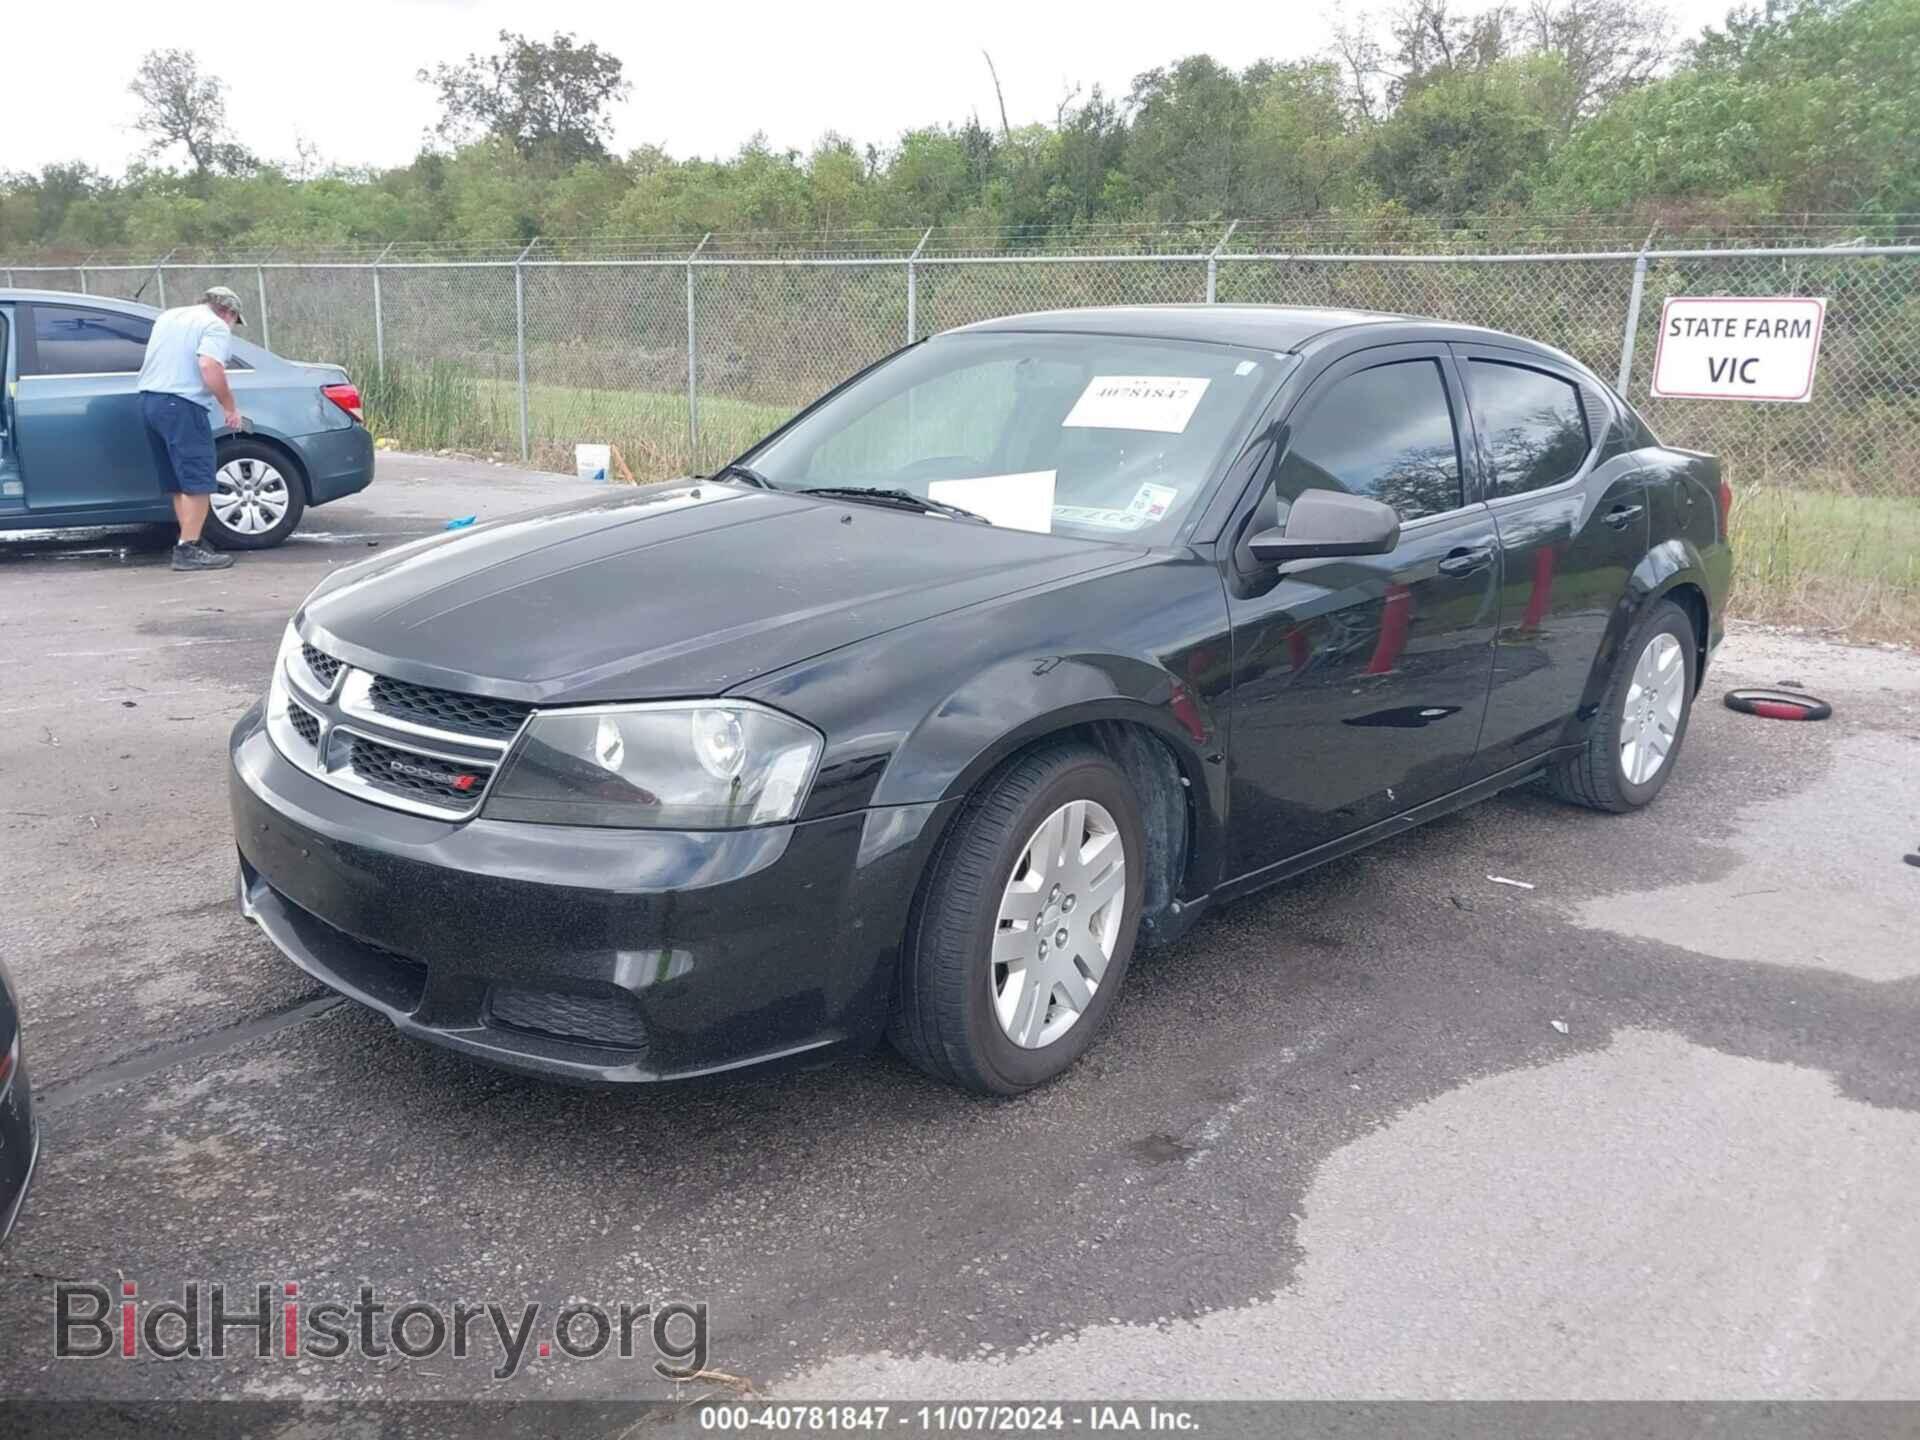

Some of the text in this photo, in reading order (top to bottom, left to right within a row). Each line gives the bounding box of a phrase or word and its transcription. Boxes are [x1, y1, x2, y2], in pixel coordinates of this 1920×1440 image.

[1669, 317, 1811, 339] STATE FARM
[1708, 357, 1760, 384] VIC
